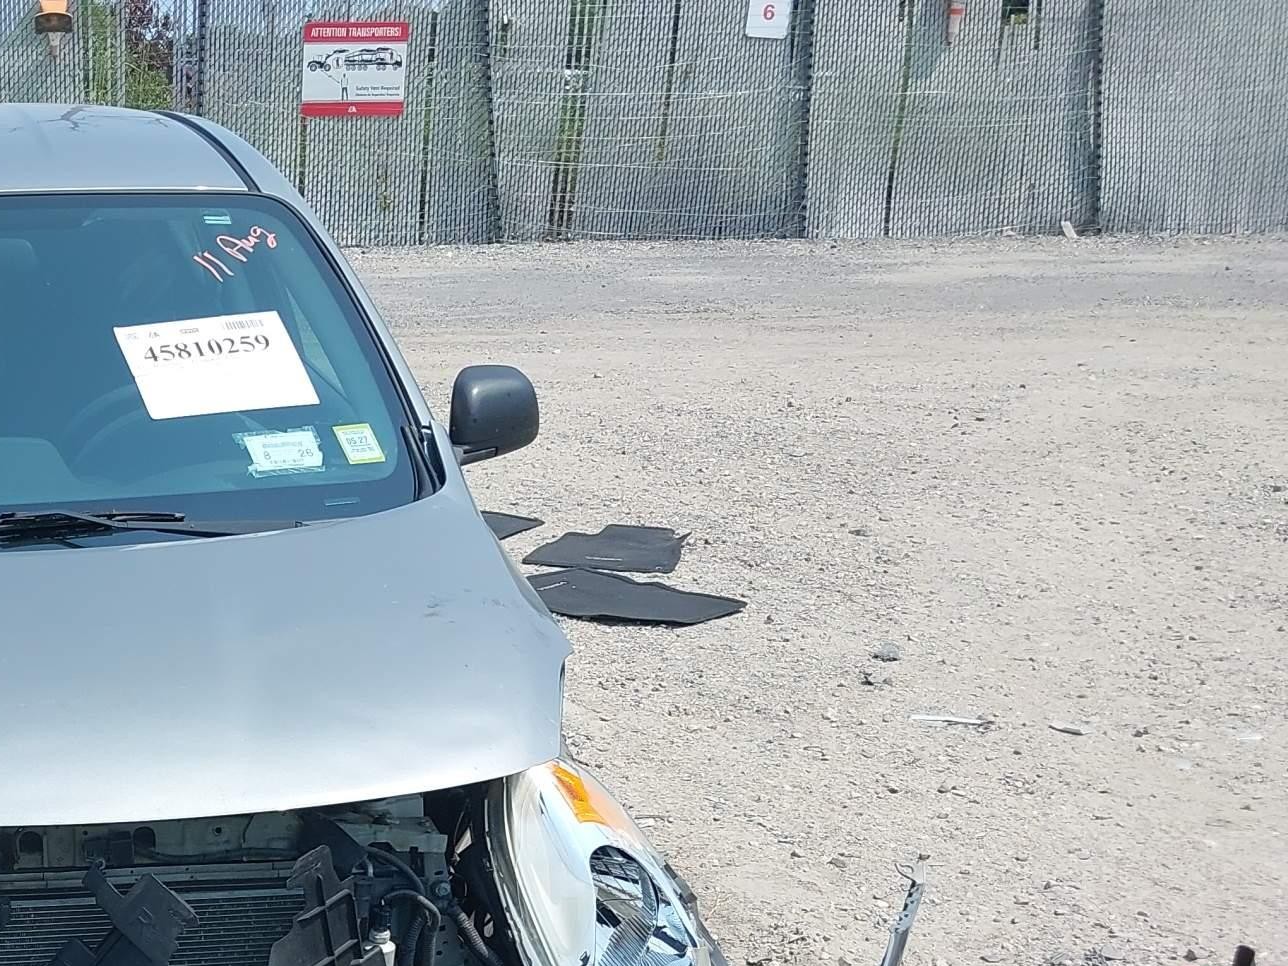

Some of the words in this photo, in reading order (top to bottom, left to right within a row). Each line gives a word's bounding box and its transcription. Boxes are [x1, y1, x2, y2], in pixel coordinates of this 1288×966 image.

[763, 4, 775, 20] 6
[310, 27, 347, 37] ATTENTION
[349, 26, 402, 37] TRANSPORTERS!
[144, 333, 270, 363] 45810259
